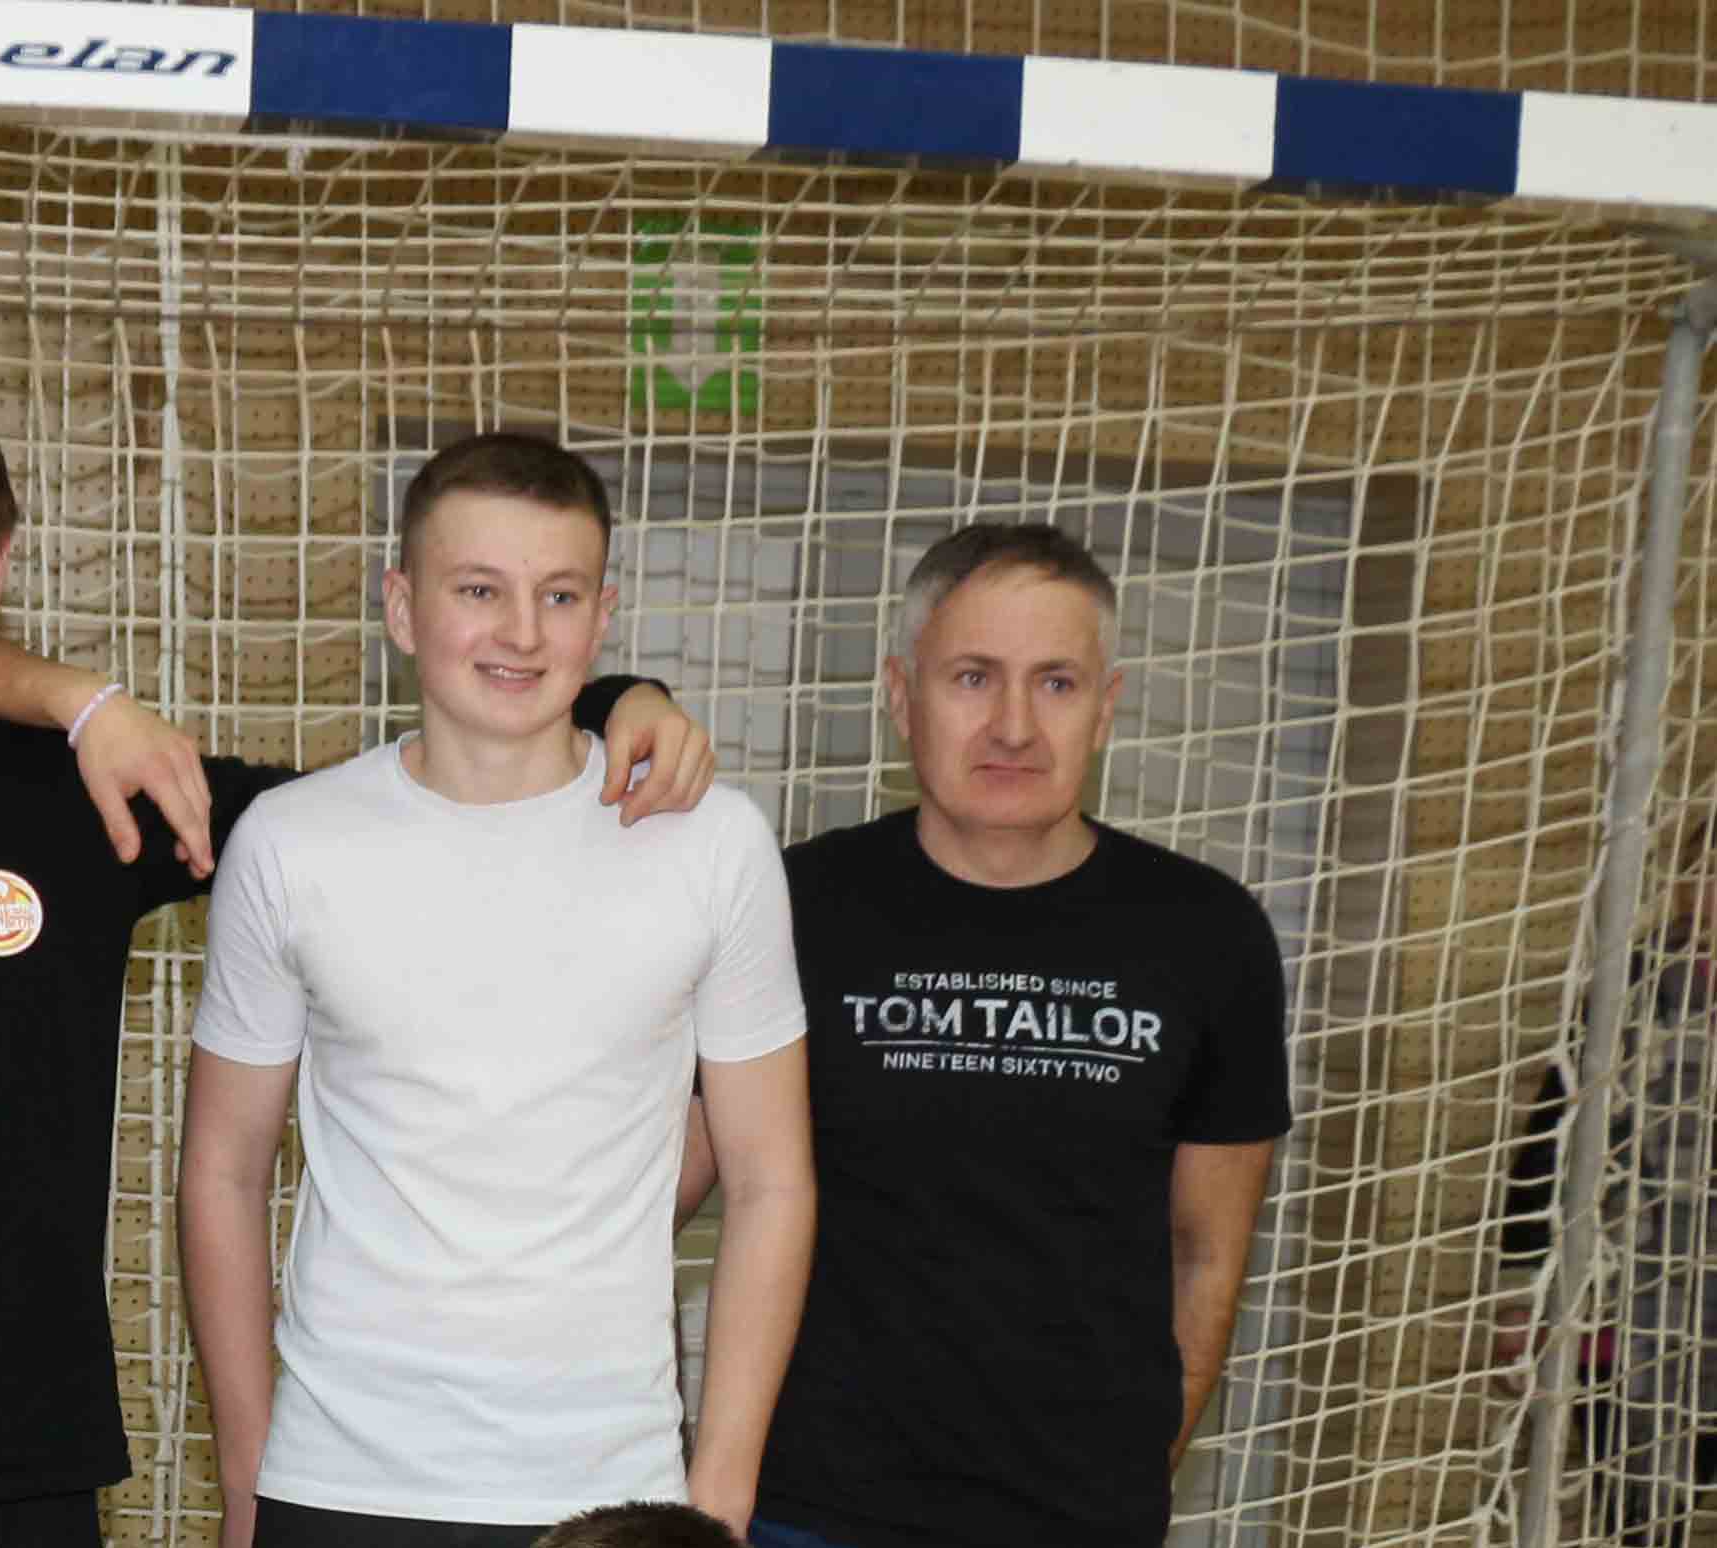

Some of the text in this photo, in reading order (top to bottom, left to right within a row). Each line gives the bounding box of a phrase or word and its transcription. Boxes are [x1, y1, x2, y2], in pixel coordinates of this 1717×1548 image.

[893, 972, 1118, 999] ESTABLISHED SINCE
[843, 994, 1162, 1052] TOM TAILOR
[883, 1050, 1121, 1083] NINETEEN SIXTY TWO
